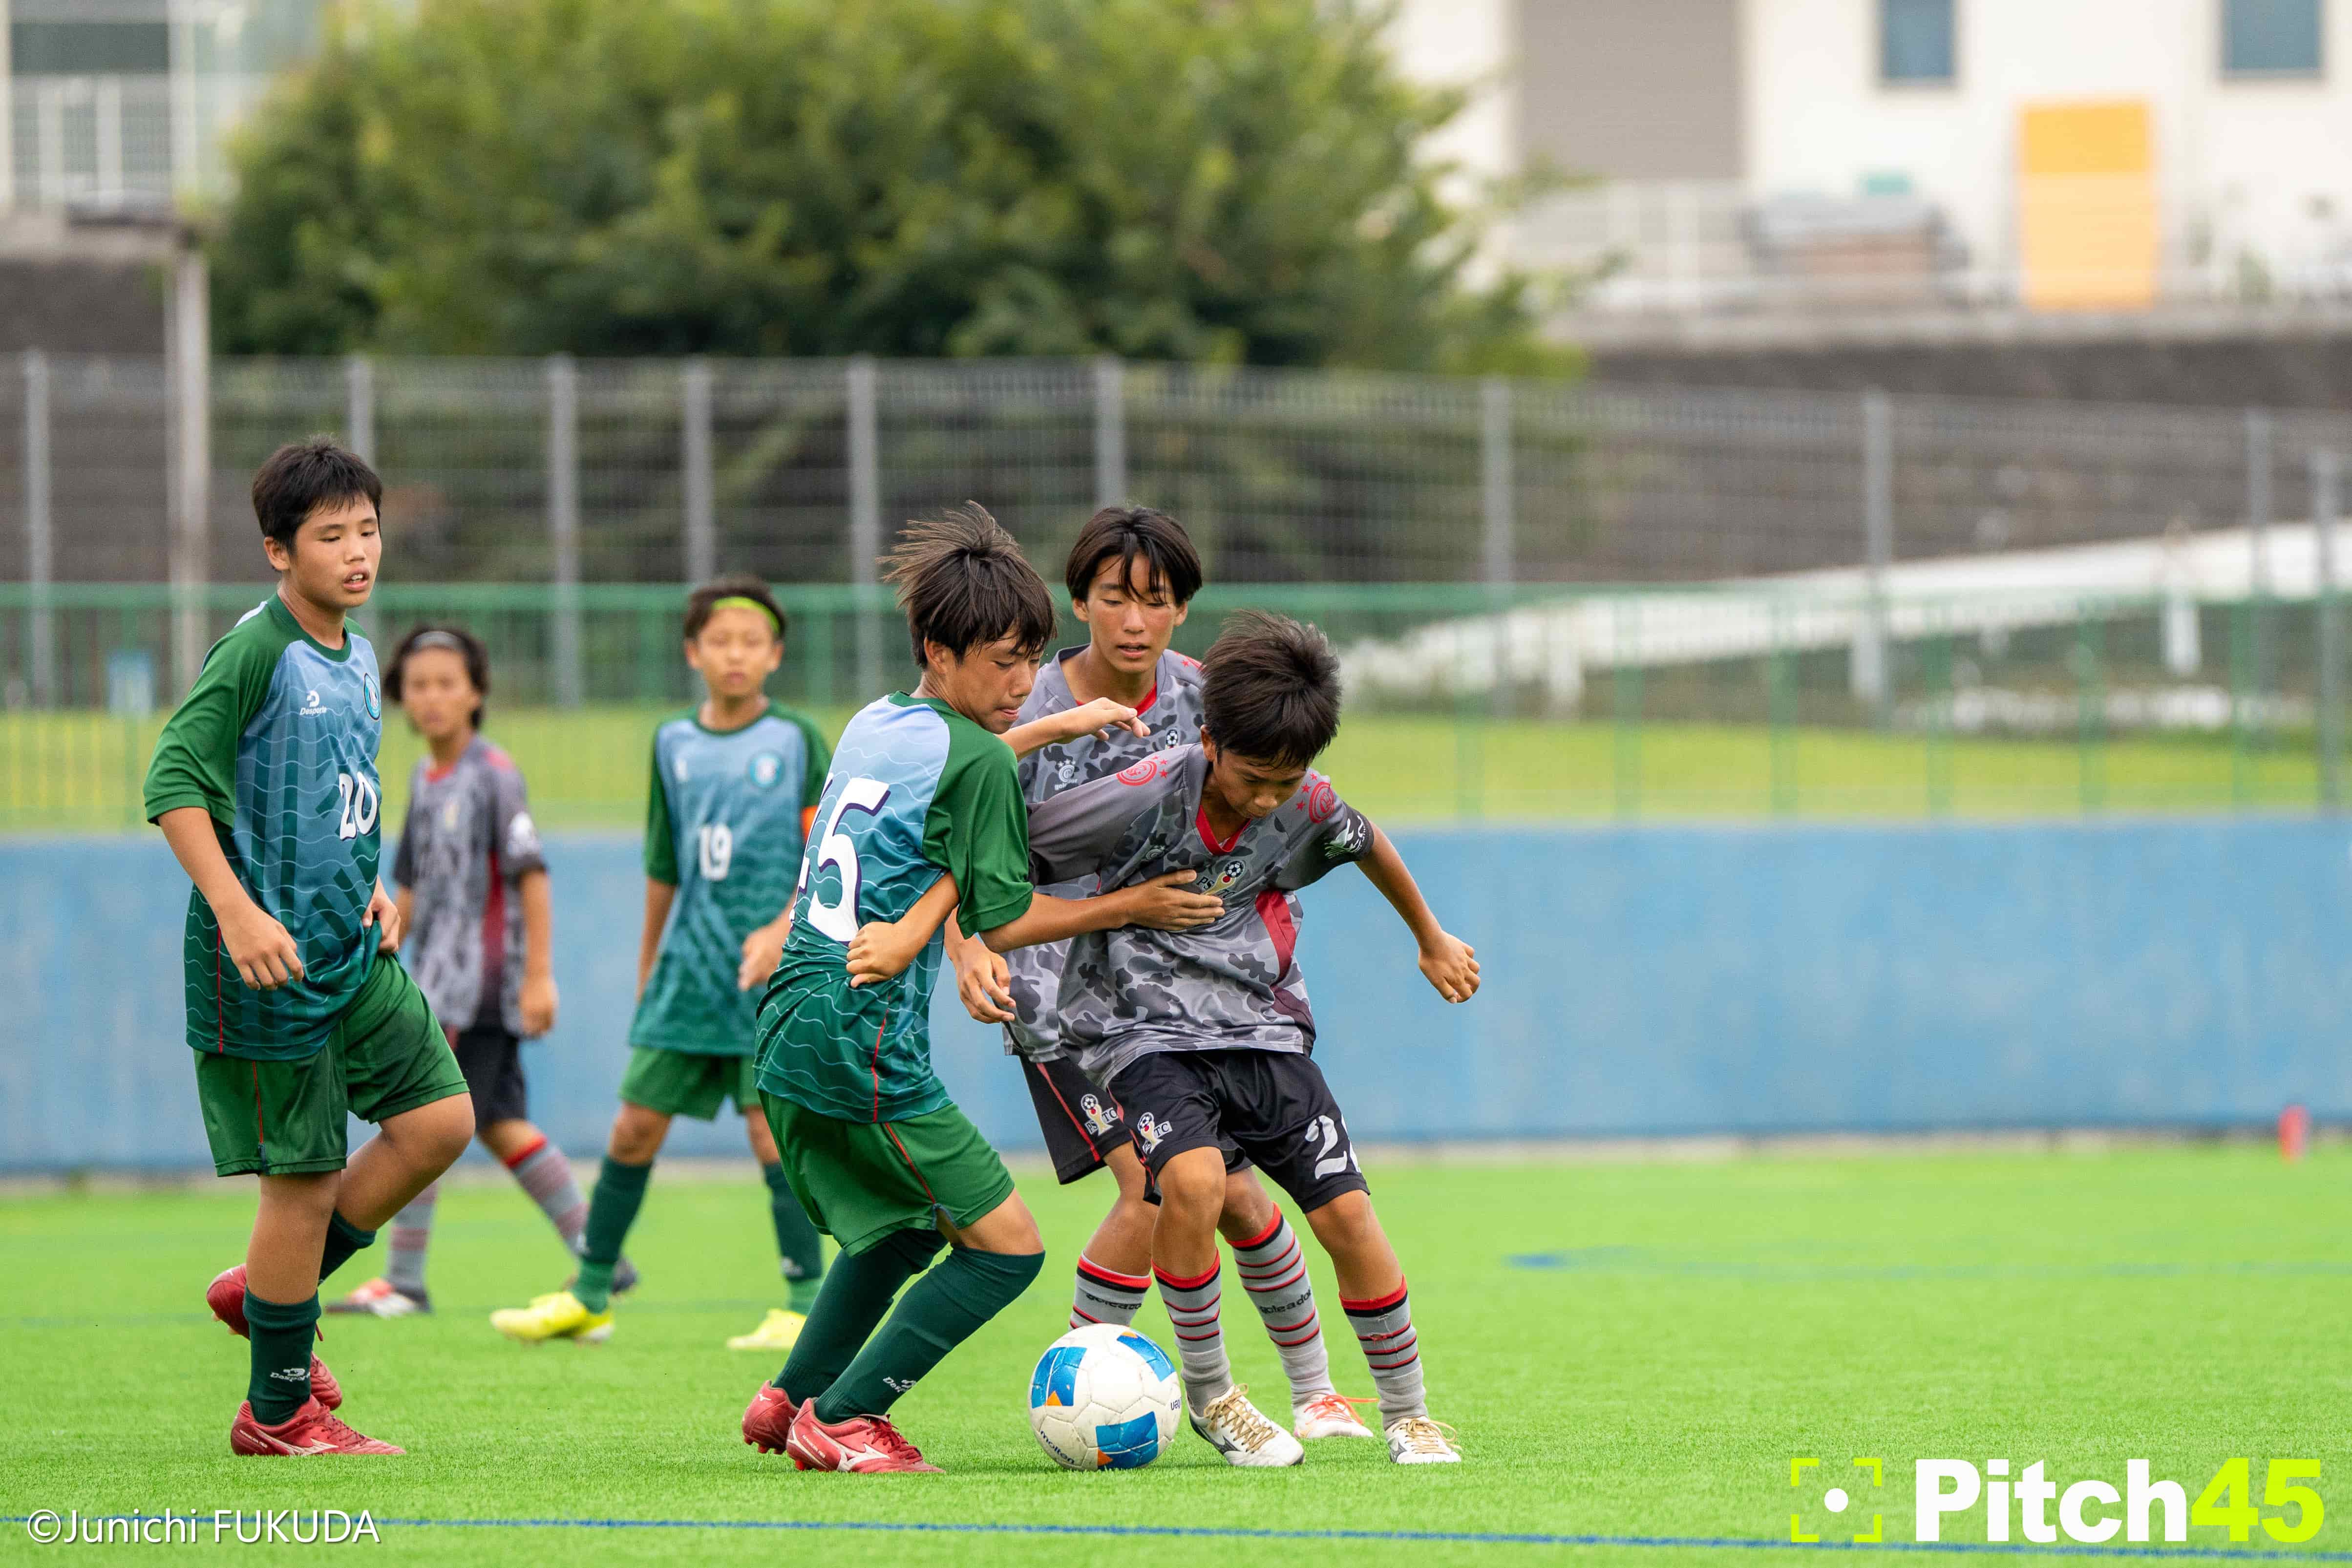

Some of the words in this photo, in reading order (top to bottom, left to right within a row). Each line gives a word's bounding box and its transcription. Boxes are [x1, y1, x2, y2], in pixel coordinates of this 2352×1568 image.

[339, 771, 378, 841] 20
[699, 823, 732, 881] 19
[789, 772, 890, 946] 5
[1102, 1108, 1118, 1122] TC
[1154, 1123, 1169, 1136] TC
[1305, 1115, 1361, 1180] 2
[1040, 1430, 1074, 1464] molten
